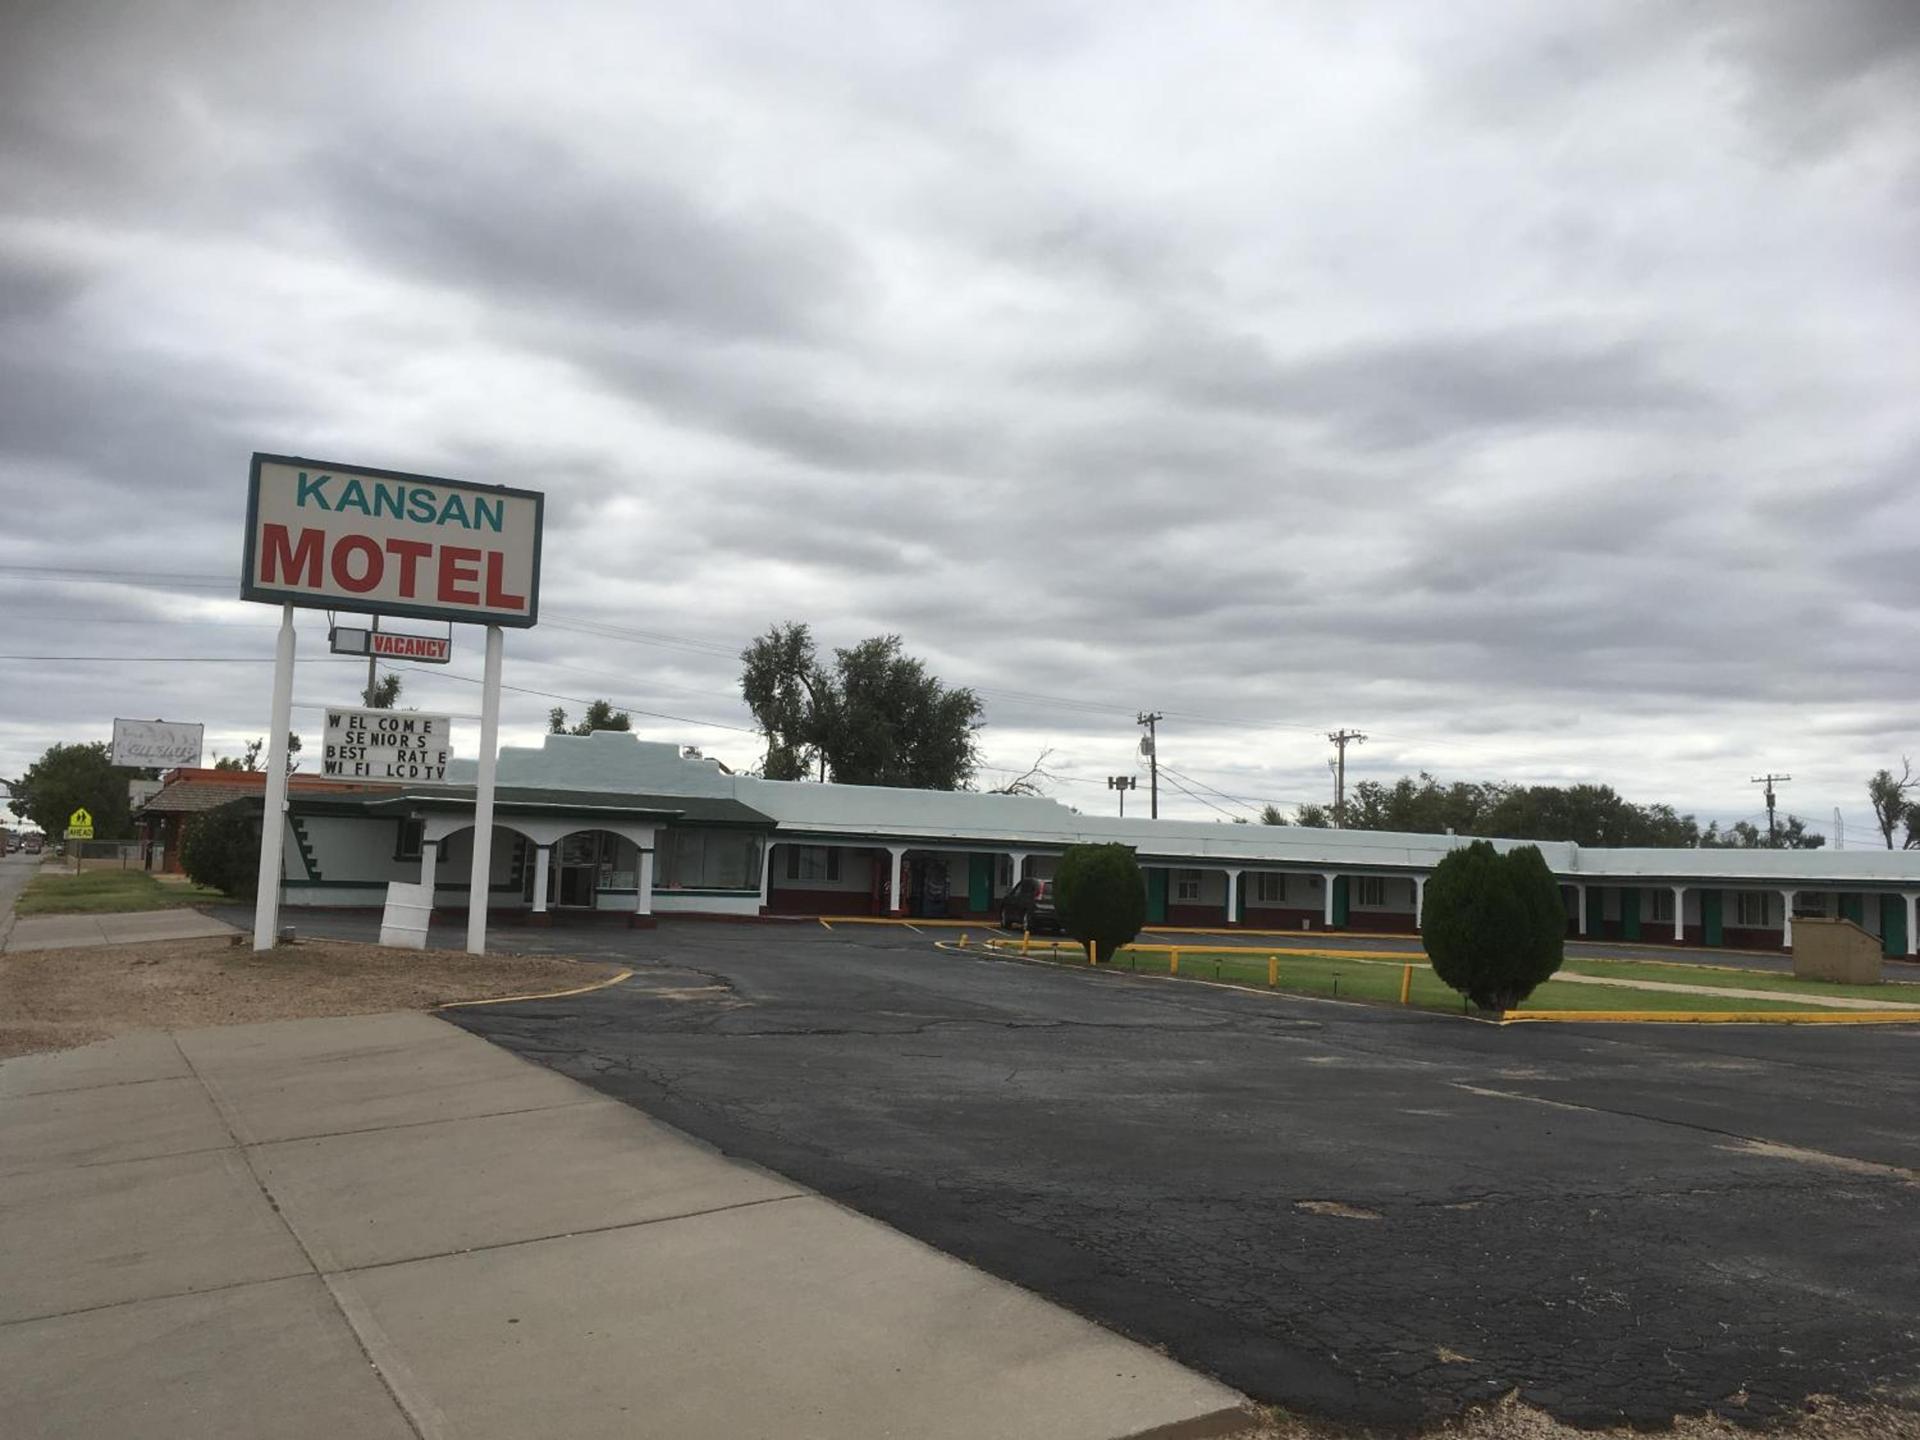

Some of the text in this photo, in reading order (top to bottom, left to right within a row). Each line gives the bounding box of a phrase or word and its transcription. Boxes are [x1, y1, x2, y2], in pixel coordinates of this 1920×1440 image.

[296, 472, 504, 532] KANSAN
[260, 523, 524, 610] MOTEL
[374, 635, 447, 658] VACANCY
[329, 715, 432, 733] WELCOME
[345, 731, 426, 748] SENIORS
[326, 745, 447, 764] BEST RATE
